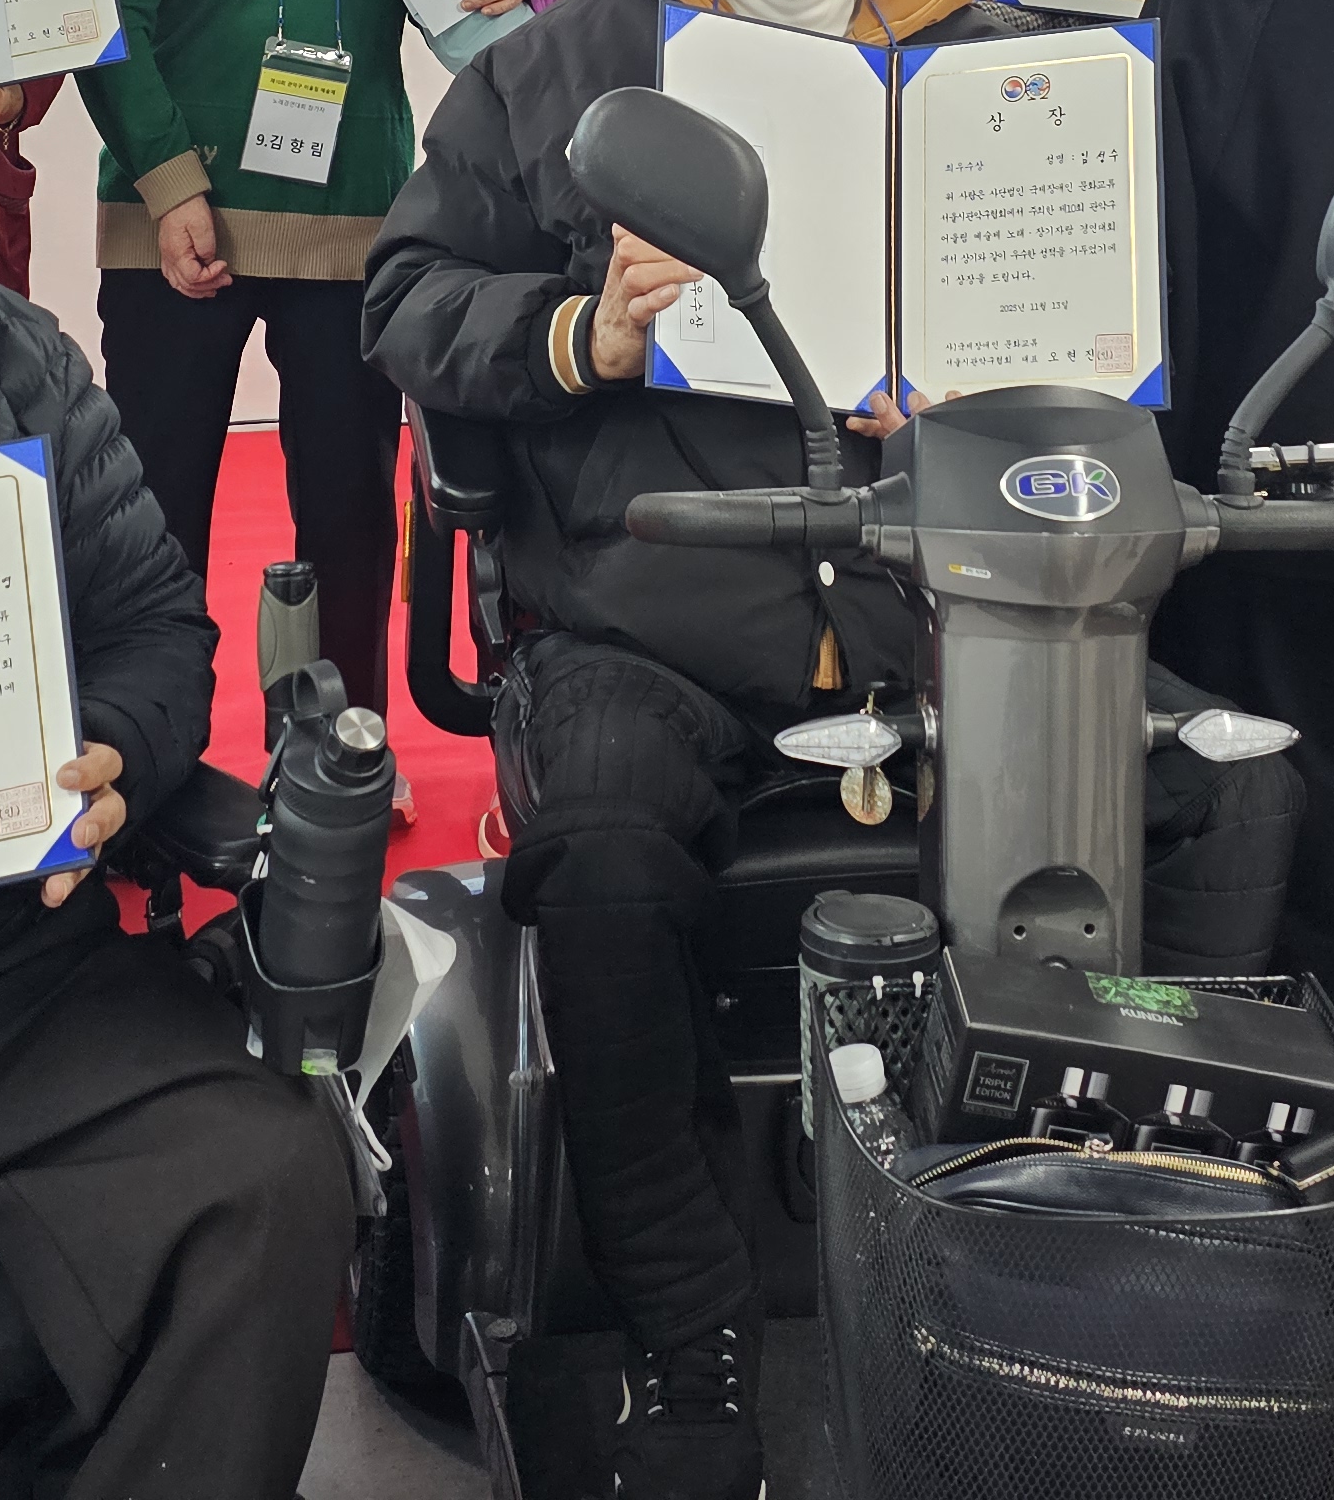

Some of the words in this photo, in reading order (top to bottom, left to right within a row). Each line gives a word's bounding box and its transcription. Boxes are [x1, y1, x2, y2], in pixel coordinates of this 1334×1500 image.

[986, 112, 1005, 132] 상
[1046, 106, 1066, 126] 장
[1120, 1007, 1184, 1027] KUNDAL
[979, 1076, 1013, 1089] TRIPLE
[975, 1086, 1011, 1100] EDITION
